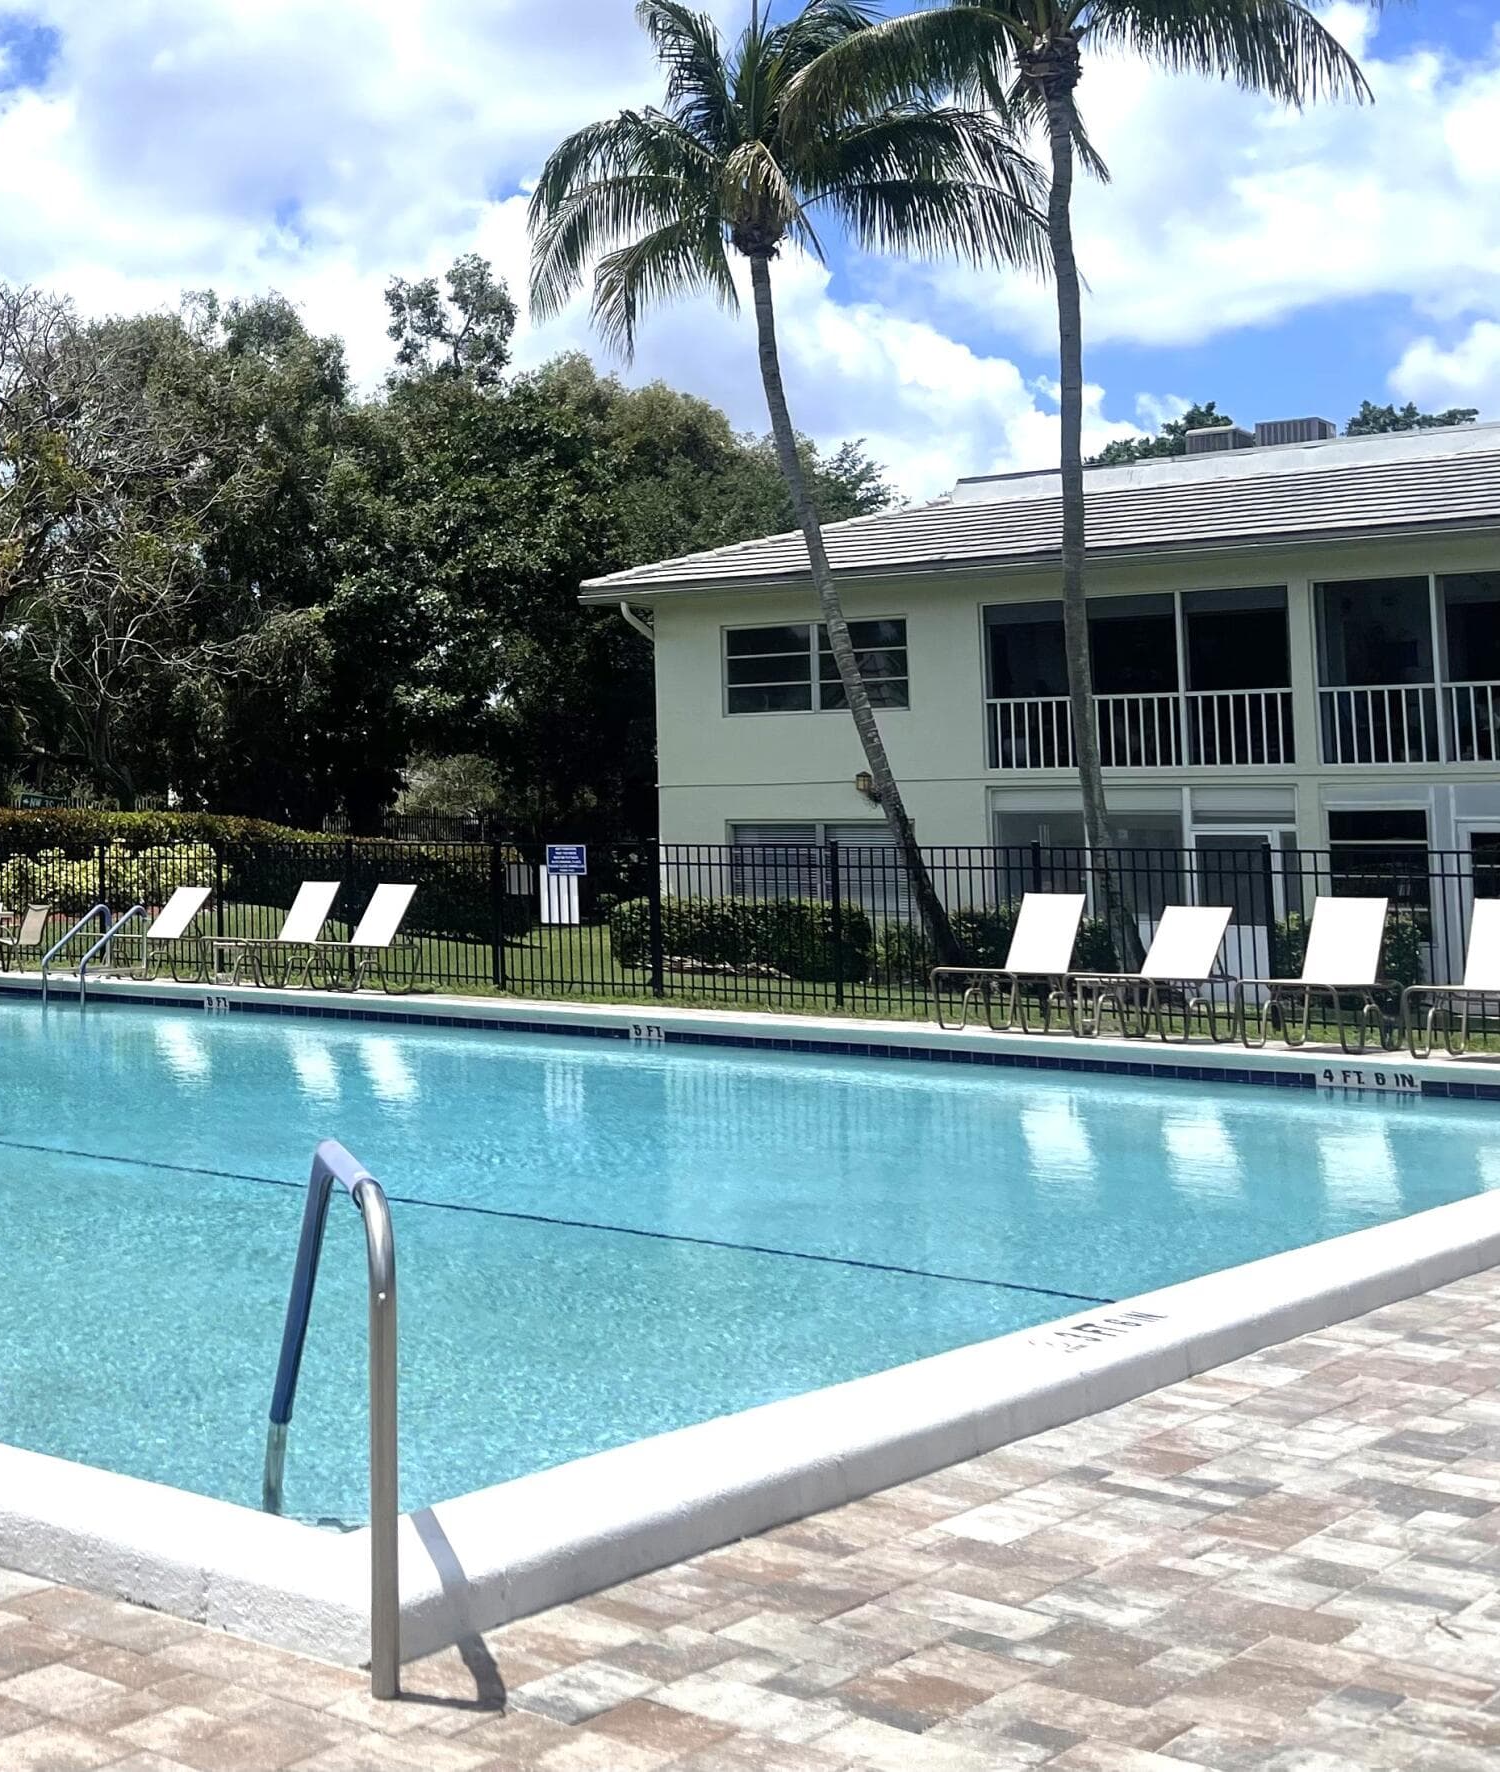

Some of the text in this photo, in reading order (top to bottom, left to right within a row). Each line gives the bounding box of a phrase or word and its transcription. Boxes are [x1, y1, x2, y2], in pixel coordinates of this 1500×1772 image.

[632, 1024, 642, 1036] 5
[1323, 1069, 1335, 1083] 4
[1374, 1072, 1386, 1086] 6
